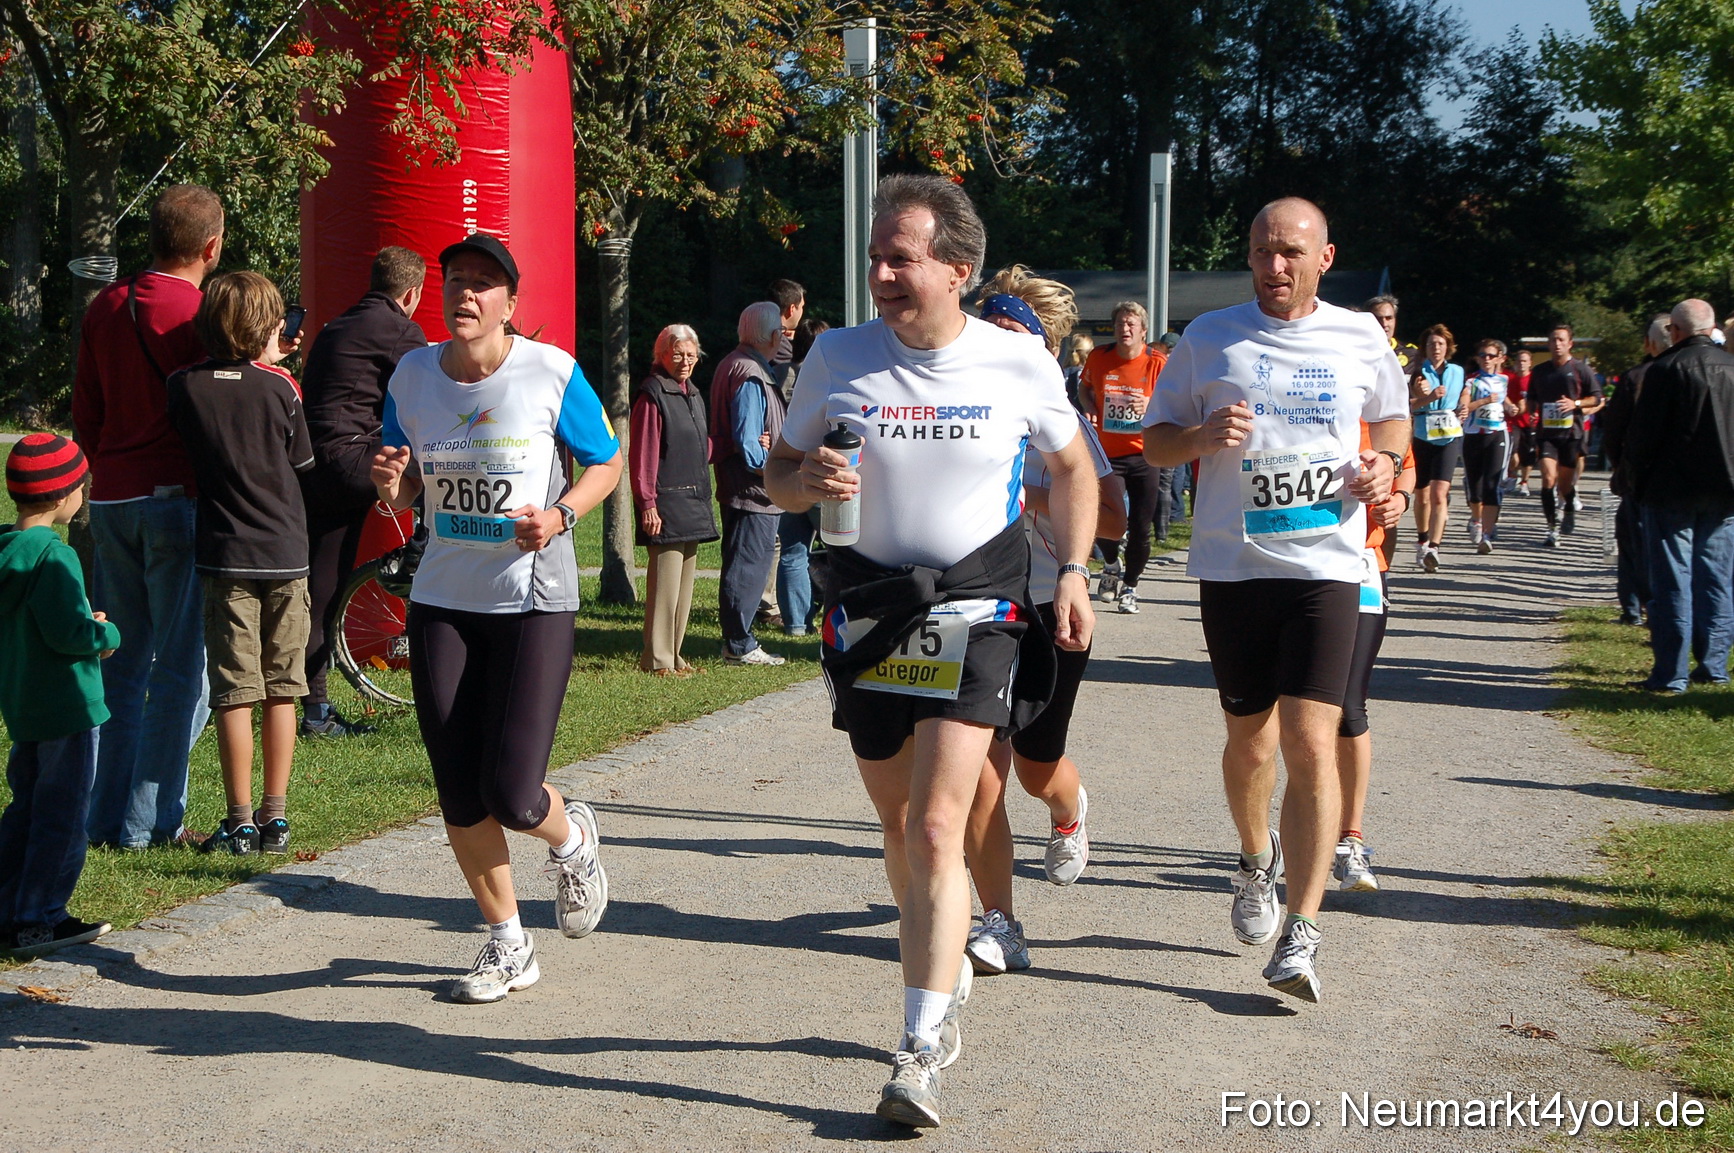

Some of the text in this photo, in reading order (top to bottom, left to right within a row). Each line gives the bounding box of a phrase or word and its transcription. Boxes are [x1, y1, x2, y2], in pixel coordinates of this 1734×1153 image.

[463, 179, 477, 241] eit 1929
[1292, 381, 1337, 389] 16.09.2007
[881, 405, 992, 420] INTERSPORT
[1254, 403, 1336, 416] 8. Neumarkter
[1287, 415, 1336, 425] Stadtlauf
[877, 423, 981, 440] TAHEDL
[434, 461, 477, 470] PFLEIDERER
[1253, 454, 1299, 466] PFLEIDERER
[1252, 466, 1336, 509] 3542
[436, 478, 513, 515] 2662
[451, 514, 503, 538] Sabina
[875, 660, 940, 686] Gregor
